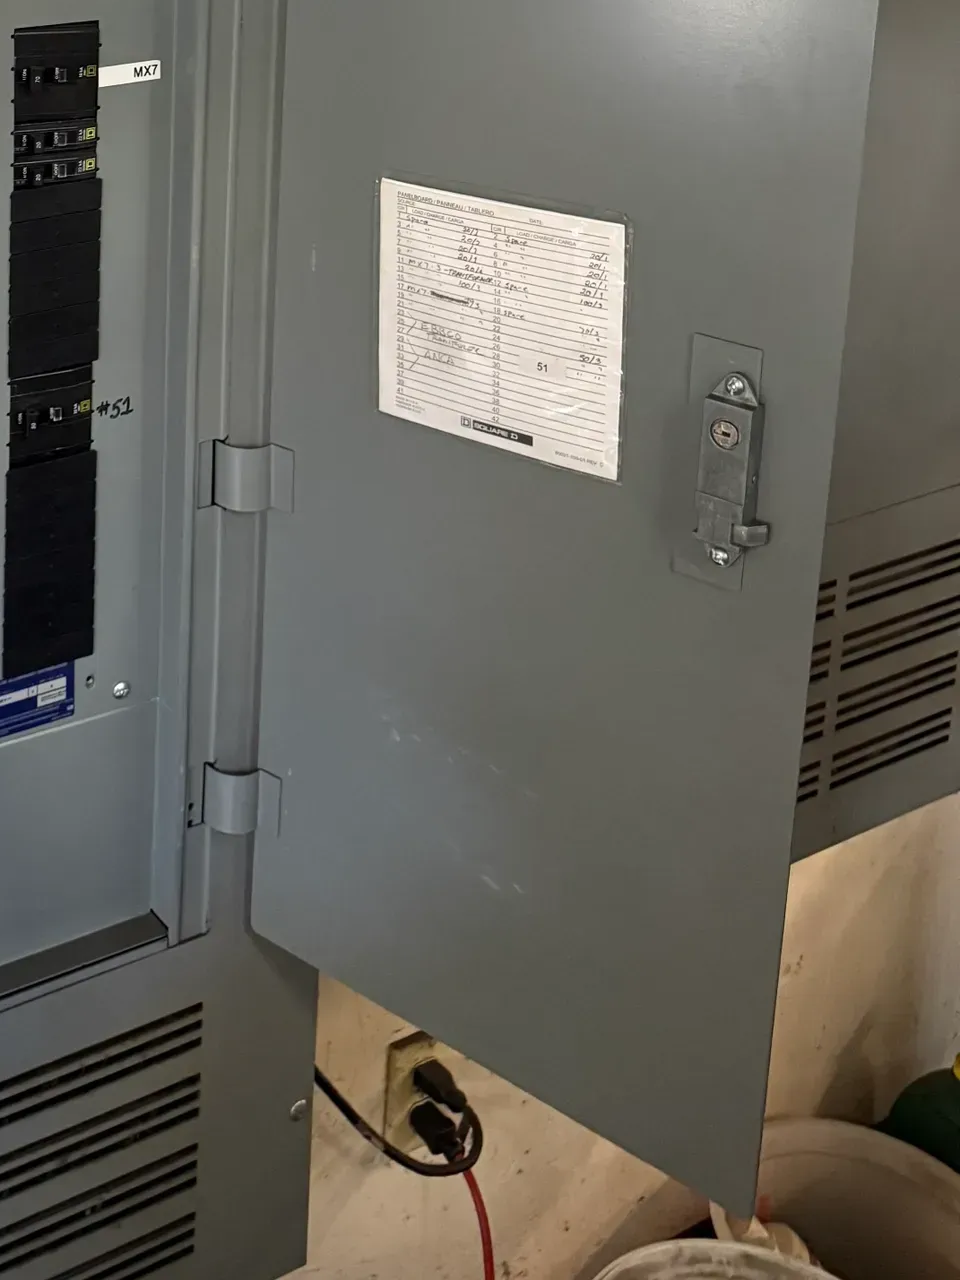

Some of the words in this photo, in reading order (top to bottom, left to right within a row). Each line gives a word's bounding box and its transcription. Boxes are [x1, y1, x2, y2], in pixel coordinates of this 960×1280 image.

[133, 64, 158, 78] MX7
[397, 191, 433, 203] PANELBOARD
[436, 200, 464, 211] PANNEAU
[467, 206, 495, 216] TABLERO
[536, 362, 548, 372] 51
[96, 396, 134, 419] #51
[473, 421, 509, 438] SQUARE
[510, 432, 519, 441] D
